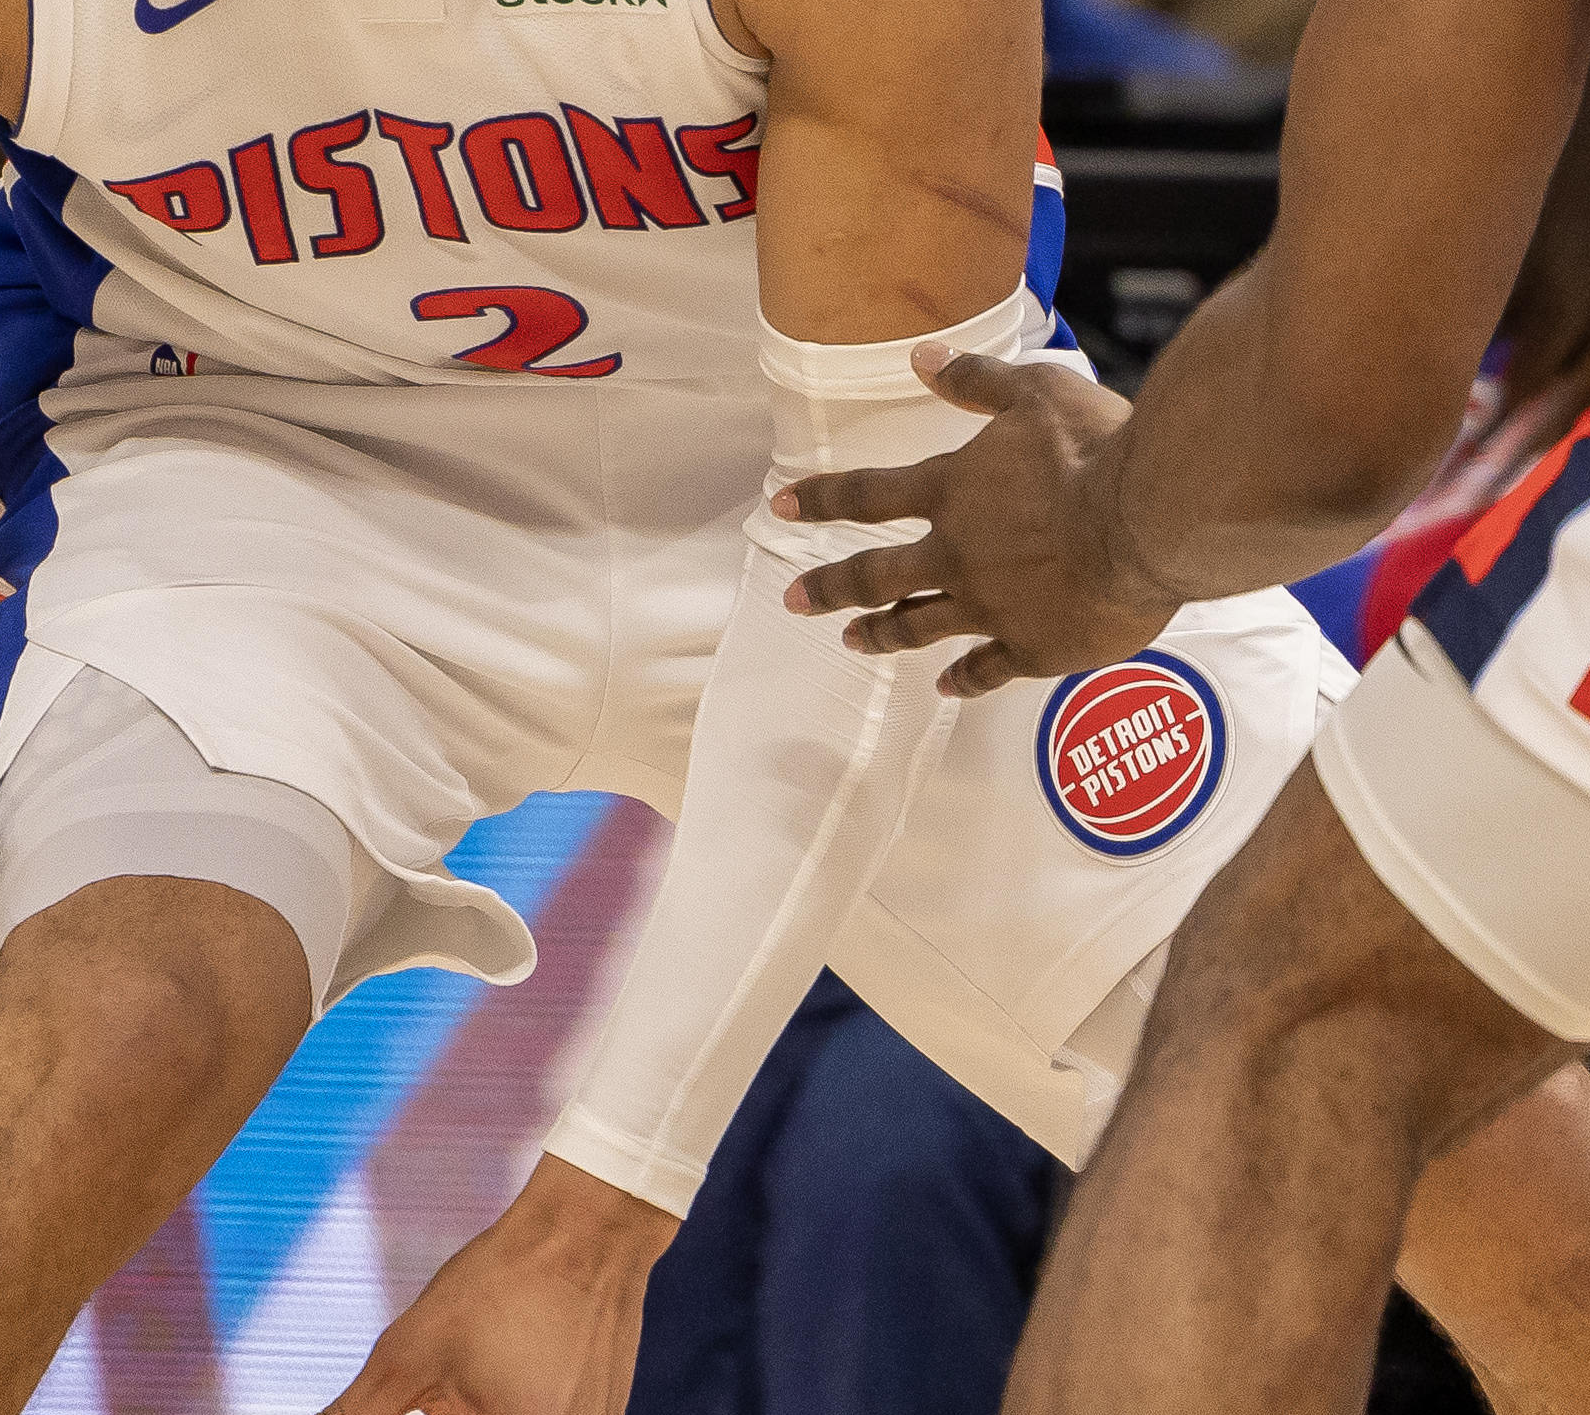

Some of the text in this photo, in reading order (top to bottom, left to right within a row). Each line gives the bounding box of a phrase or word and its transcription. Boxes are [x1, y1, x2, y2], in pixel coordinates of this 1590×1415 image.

[102, 102, 760, 266] PISTONS
[154, 356, 178, 375] NBA
[409, 285, 623, 378] 2
[1066, 694, 1177, 778] DETROIT
[1079, 723, 1191, 808] PISTONS
